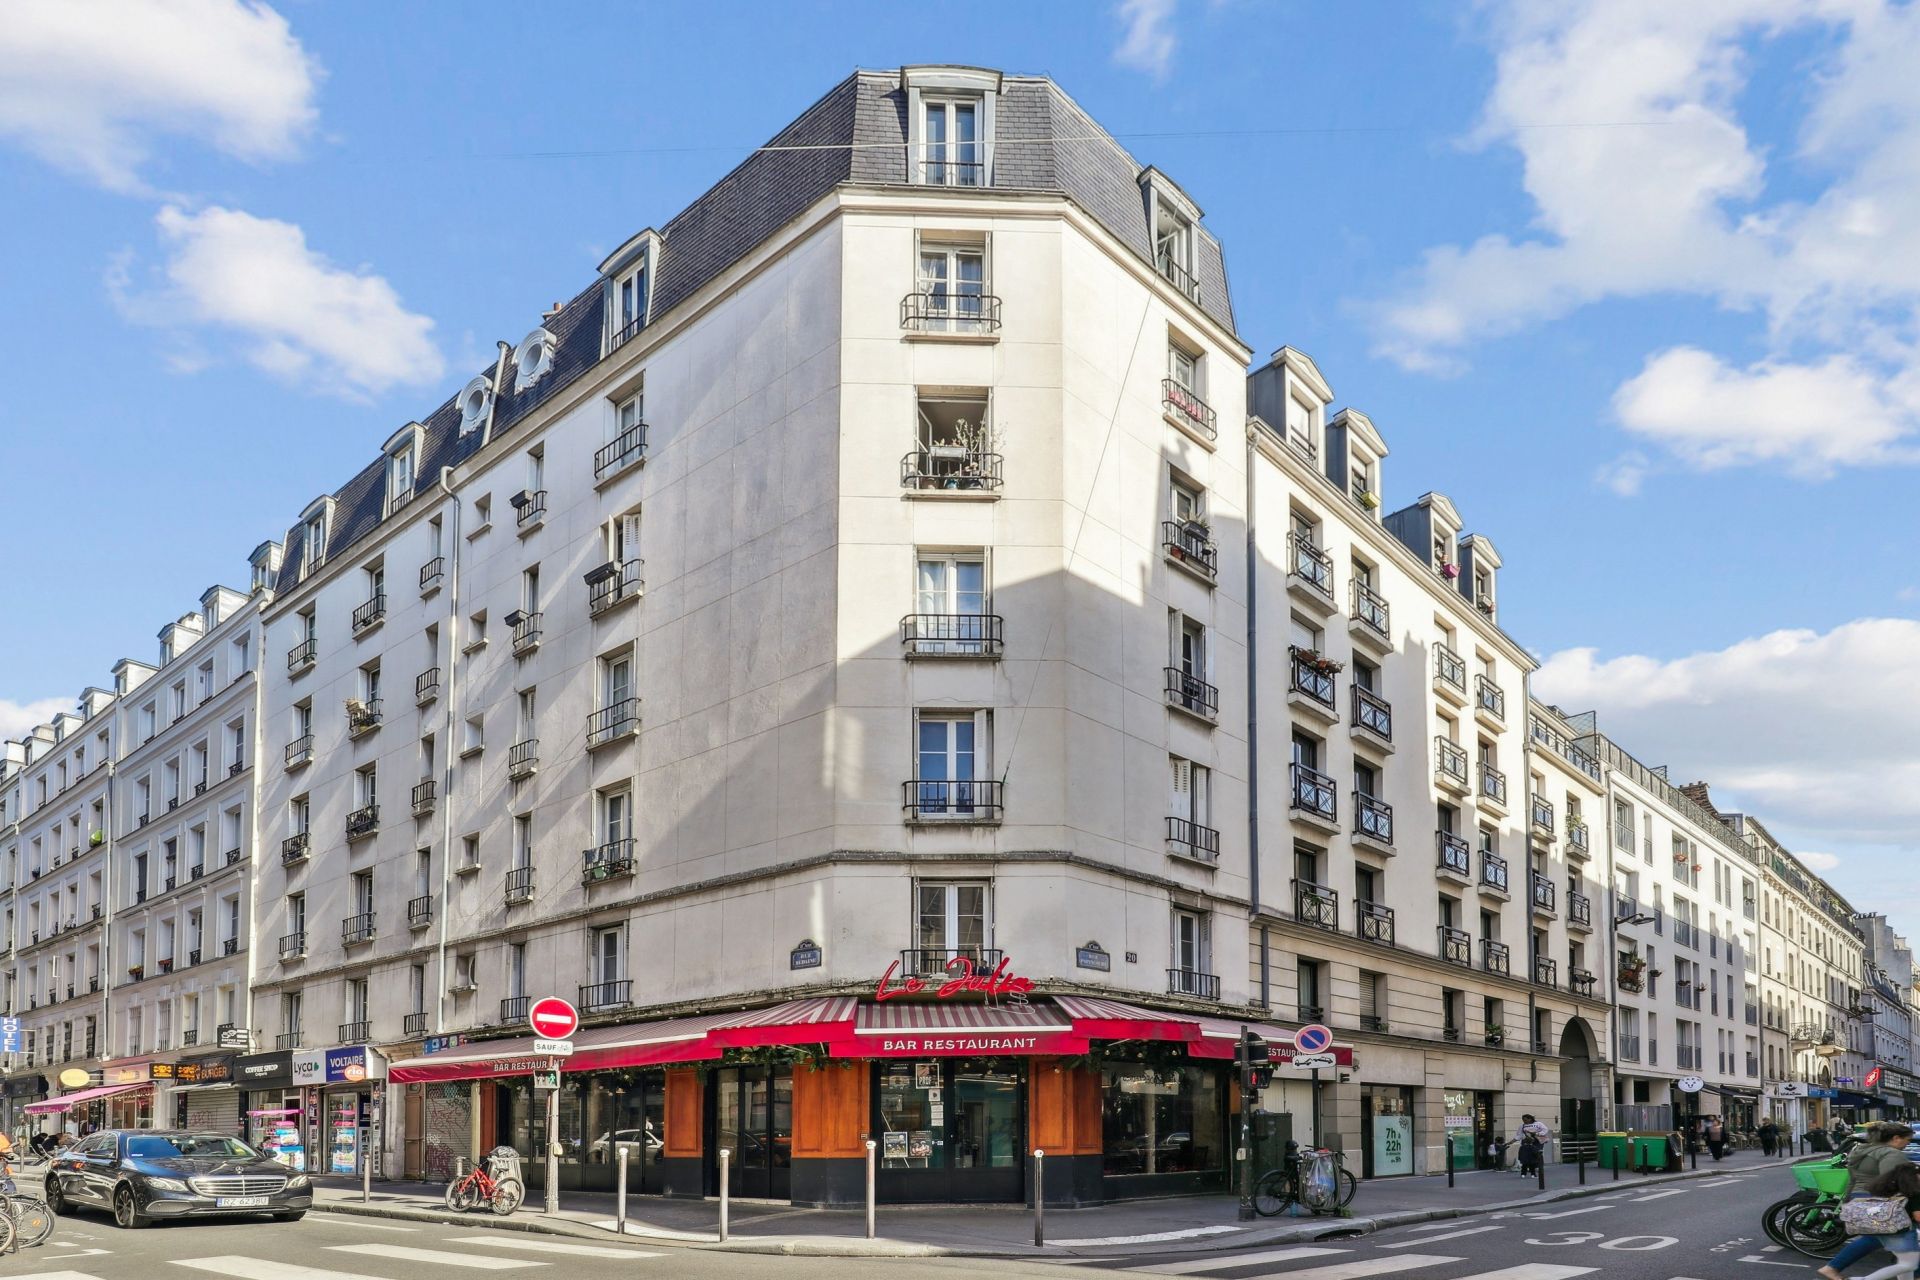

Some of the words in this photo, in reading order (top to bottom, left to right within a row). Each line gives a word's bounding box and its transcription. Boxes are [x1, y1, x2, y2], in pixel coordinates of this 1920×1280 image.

[1127, 953, 1137, 963] 20
[876, 960, 925, 1001] Le
[3, 1018, 17, 1052] HOTEL
[883, 1040, 917, 1051] BAR
[923, 1038, 1037, 1050] RESTAURANT
[330, 1055, 363, 1068] VOLTAIRE
[494, 1064, 509, 1072] BAR
[512, 1059, 565, 1070] RESTAURNT
[201, 1067, 227, 1079] BURGER
[245, 1066, 264, 1074] COFFEE
[264, 1064, 278, 1072] SHOP
[294, 1062, 313, 1075] Lyca
[1386, 1128, 1396, 1139] 7h
[1386, 1140, 1401, 1151] 22h
